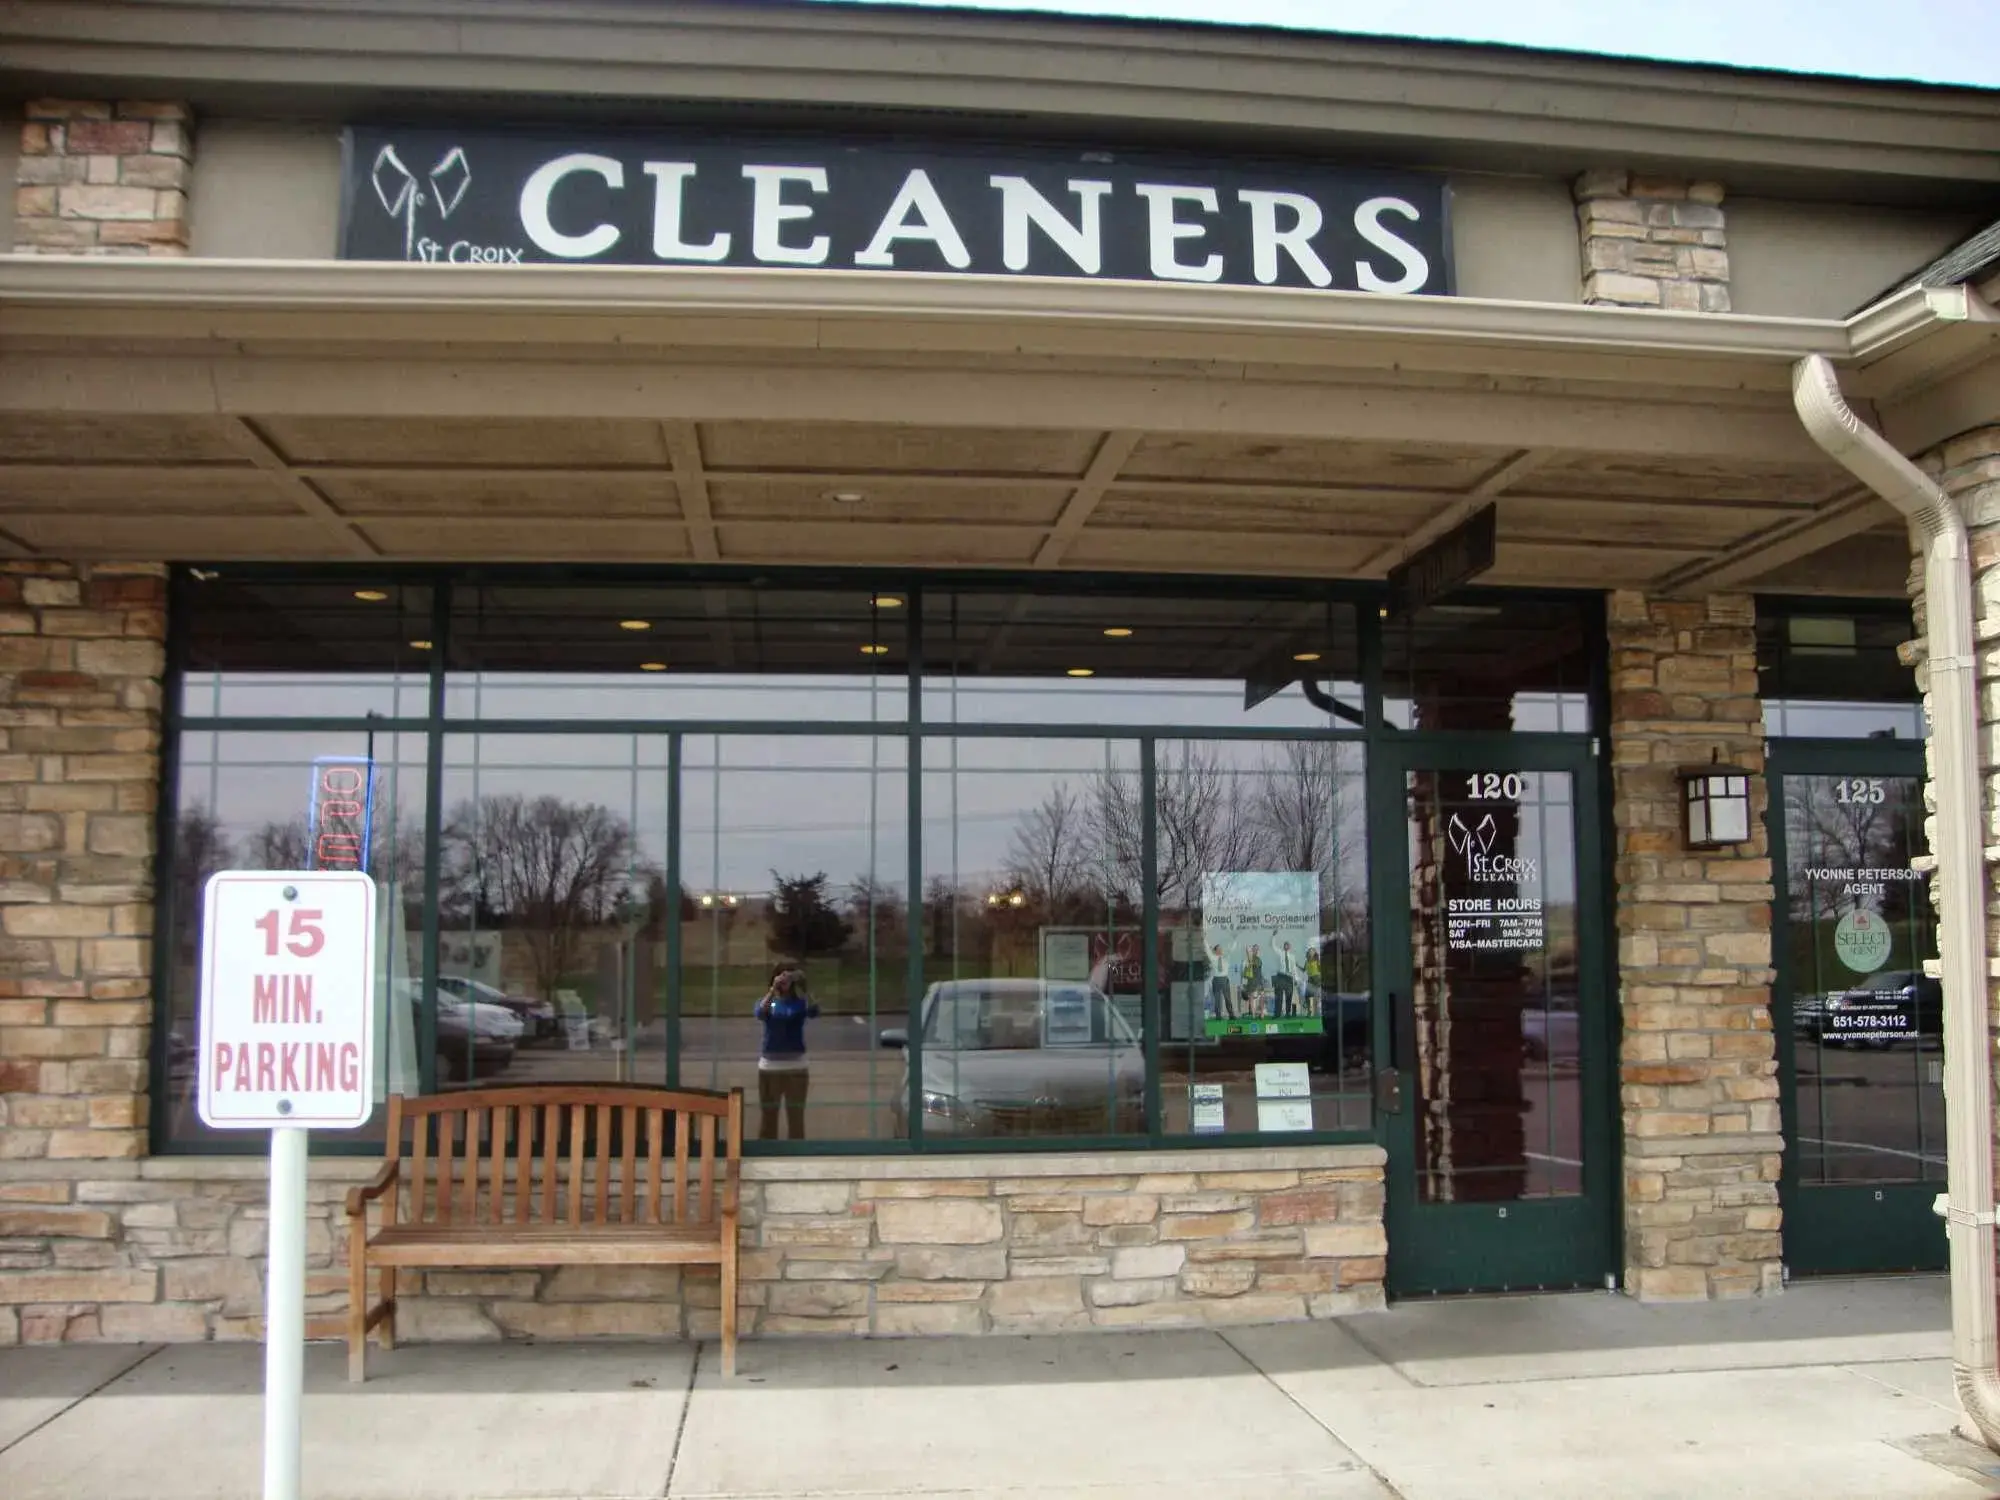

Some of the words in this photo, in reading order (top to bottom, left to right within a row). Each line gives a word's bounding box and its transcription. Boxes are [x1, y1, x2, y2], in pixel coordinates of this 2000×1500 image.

[519, 152, 1430, 294] CLEANERS
[1465, 772, 1523, 800] 120
[1835, 779, 1886, 805] 125
[318, 767, 363, 871] OPE
[1473, 872, 1537, 882] CLEANERS
[1805, 867, 1855, 881] YVONNE
[1857, 867, 1922, 881] PETERSON
[1843, 882, 1885, 895] AGENT
[1448, 899, 1492, 912] STORE
[1497, 898, 1542, 911] HOURS
[1448, 919, 1491, 929] MON-FRI
[1499, 918, 1543, 928] 7AM-7PM
[254, 908, 326, 958] 15
[1448, 929, 1467, 938] SAT
[1502, 928, 1543, 938] 9AM-3PM
[1449, 938, 1543, 949] VISA-MASTERCARD
[252, 974, 323, 1024] MIN.
[1832, 1015, 1907, 1028] 651-578-3112
[1822, 1029, 1920, 1041] www.yvonnepeterson.net
[214, 1041, 359, 1093] PARKING
